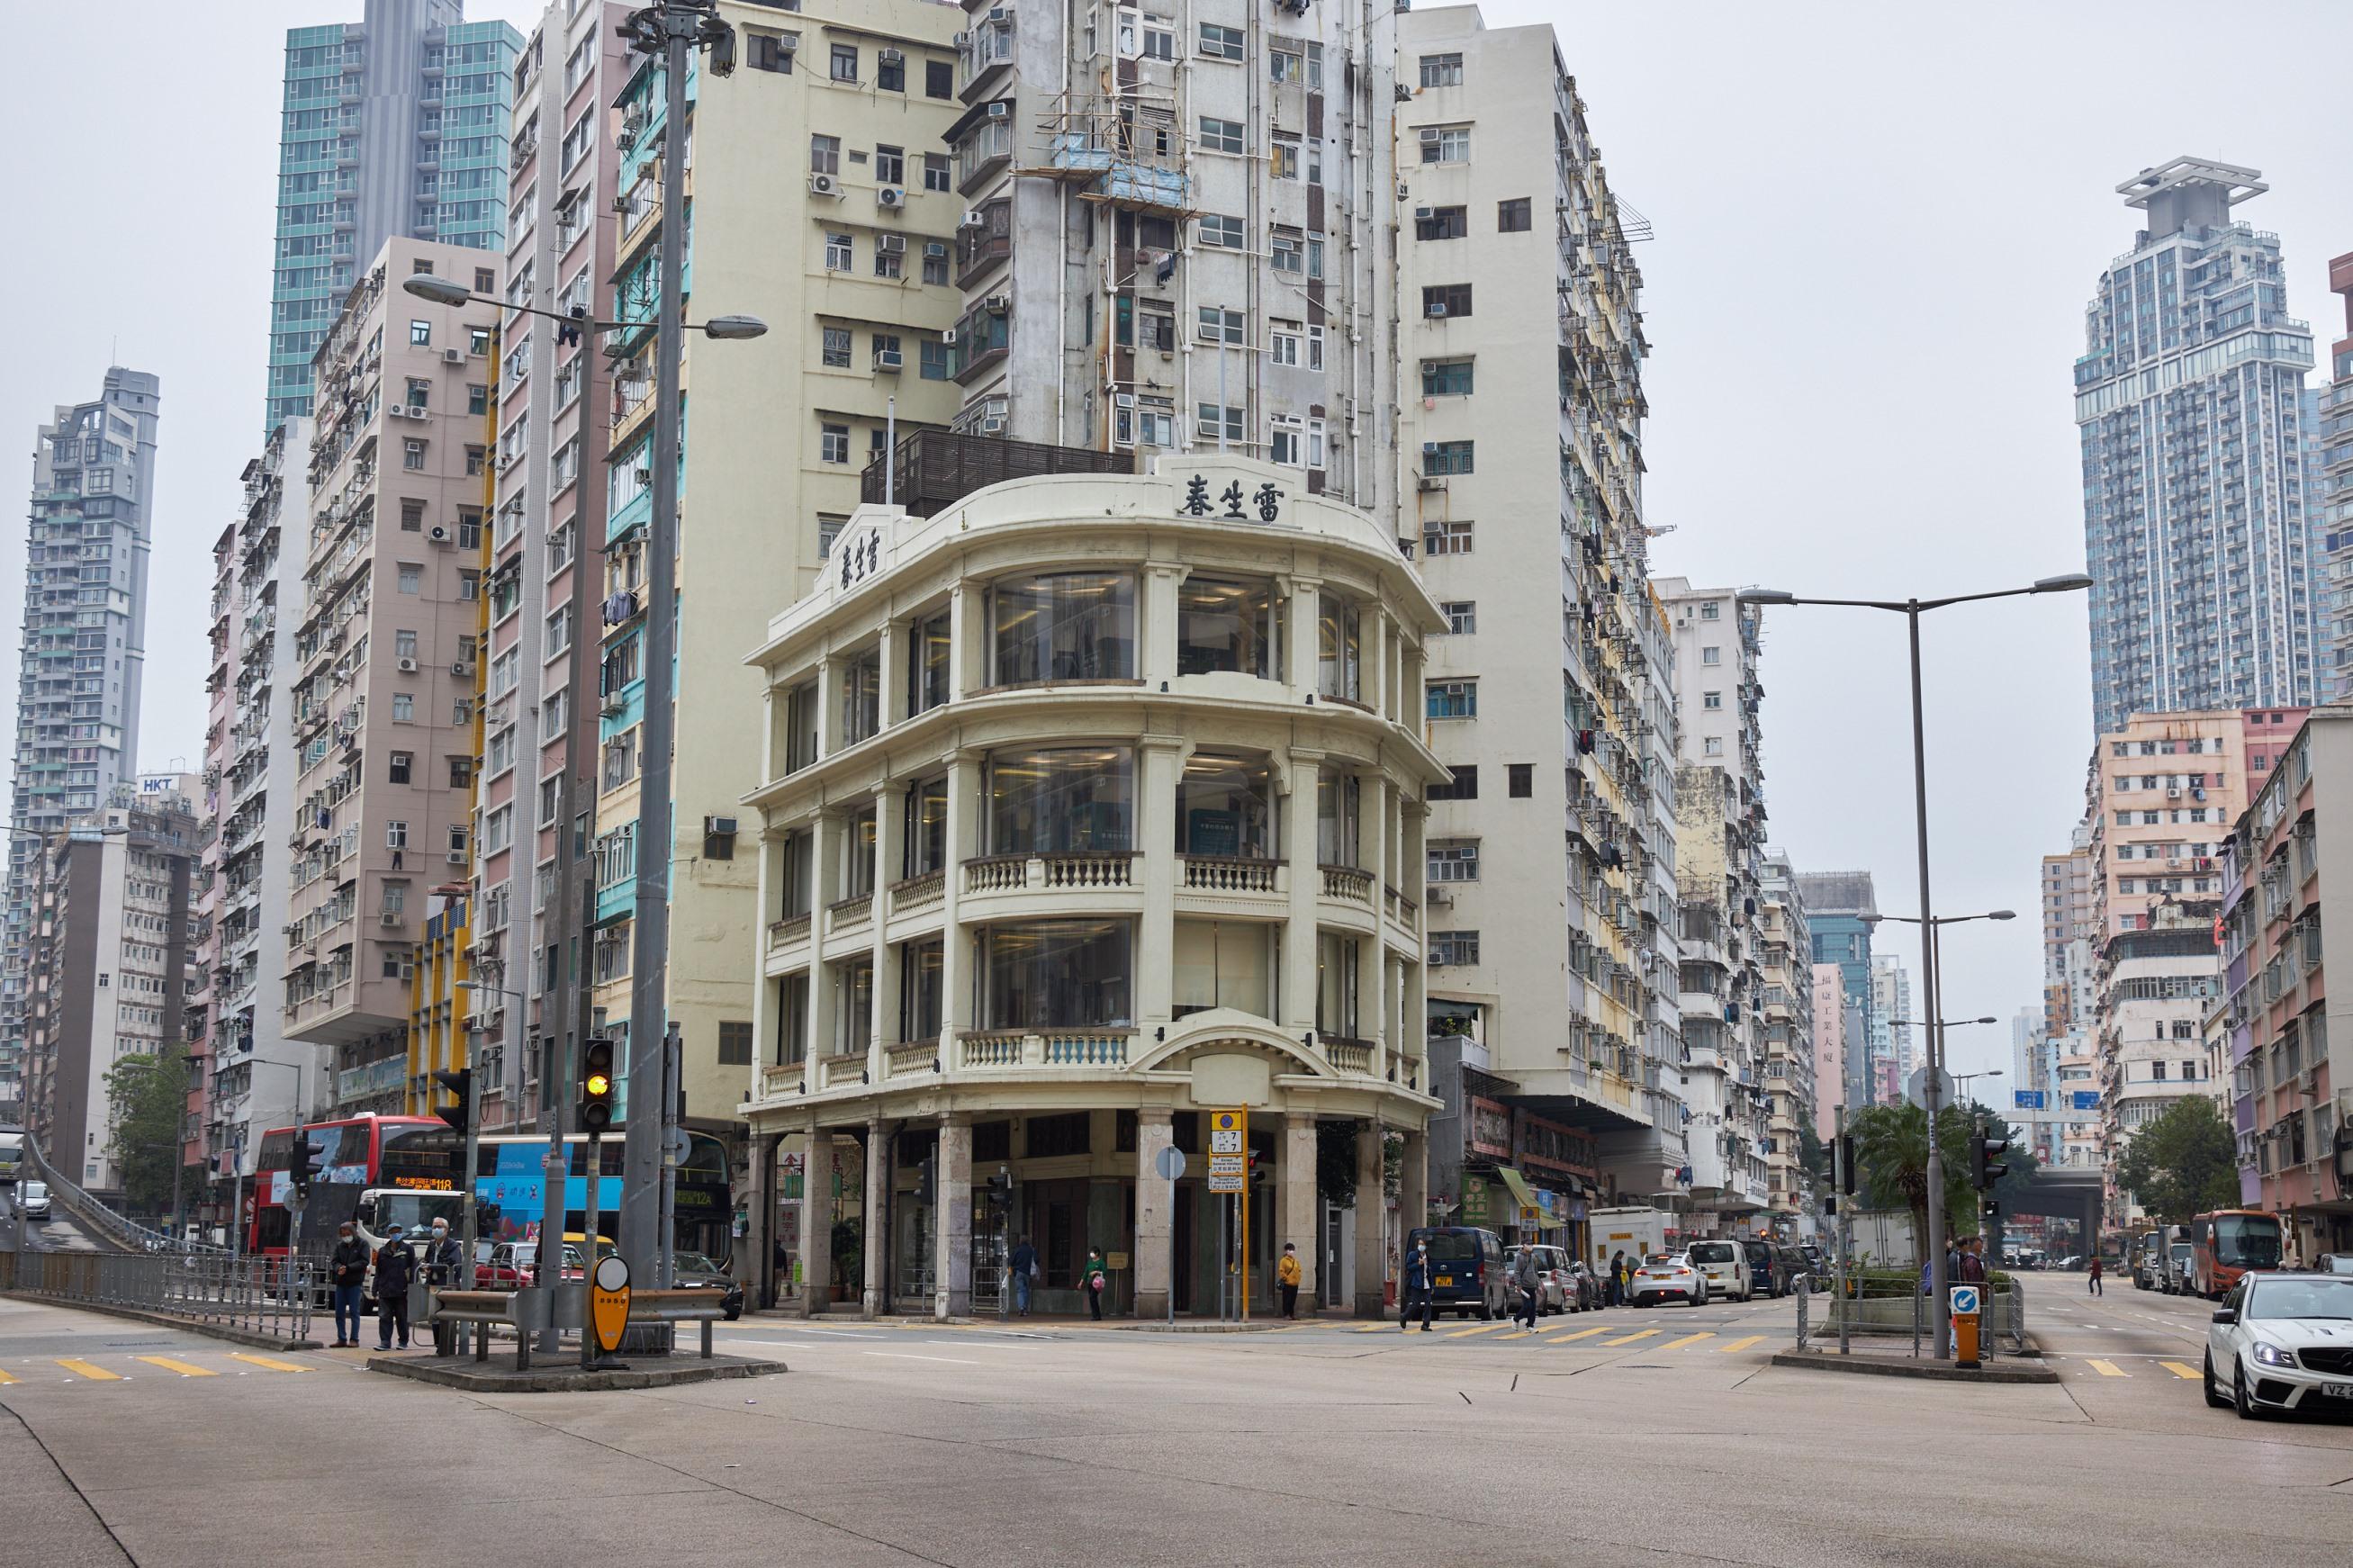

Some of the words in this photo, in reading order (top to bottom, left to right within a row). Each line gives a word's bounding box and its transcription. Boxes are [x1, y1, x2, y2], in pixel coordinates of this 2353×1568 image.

[144, 779, 172, 791] HKT
[436, 1178, 452, 1190] 118
[697, 1191, 712, 1204] 12A
[2329, 1385, 2345, 1395] VZ
